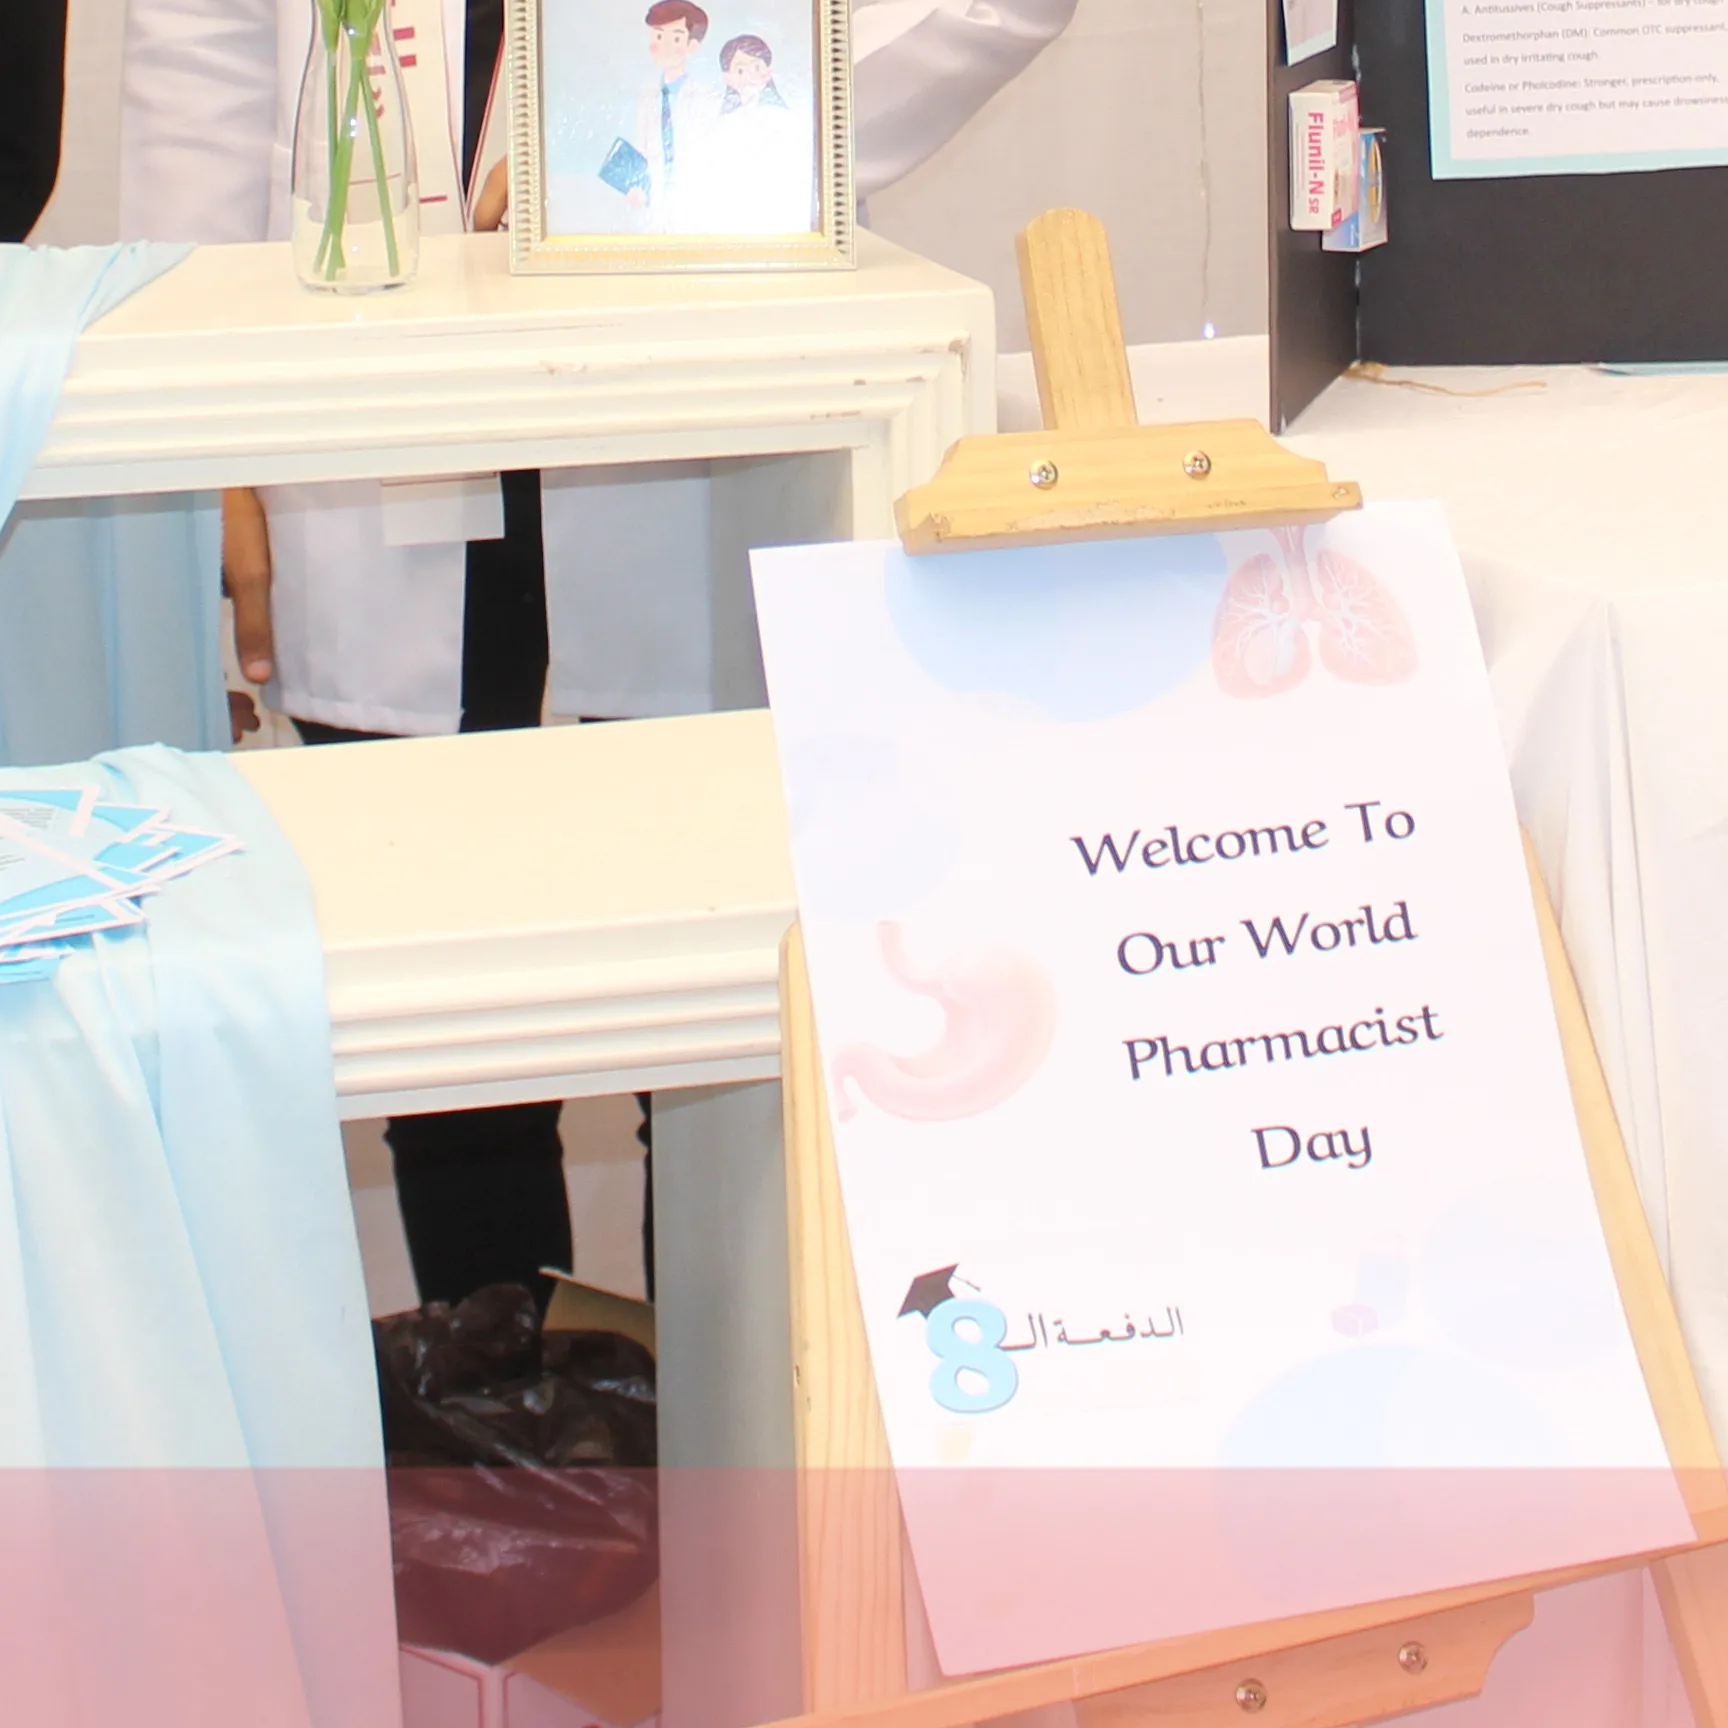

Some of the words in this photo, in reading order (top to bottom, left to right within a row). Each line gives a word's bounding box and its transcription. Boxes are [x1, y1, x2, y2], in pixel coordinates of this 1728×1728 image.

[1071, 809, 1329, 876] Welcome
[1343, 799, 1417, 846] To
[1116, 924, 1227, 976] Our
[1240, 900, 1419, 959] World
[1122, 1002, 1445, 1080] Pharmacist
[1251, 1119, 1375, 1171] Day
[1053, 1305, 1186, 1346] الدفعة
